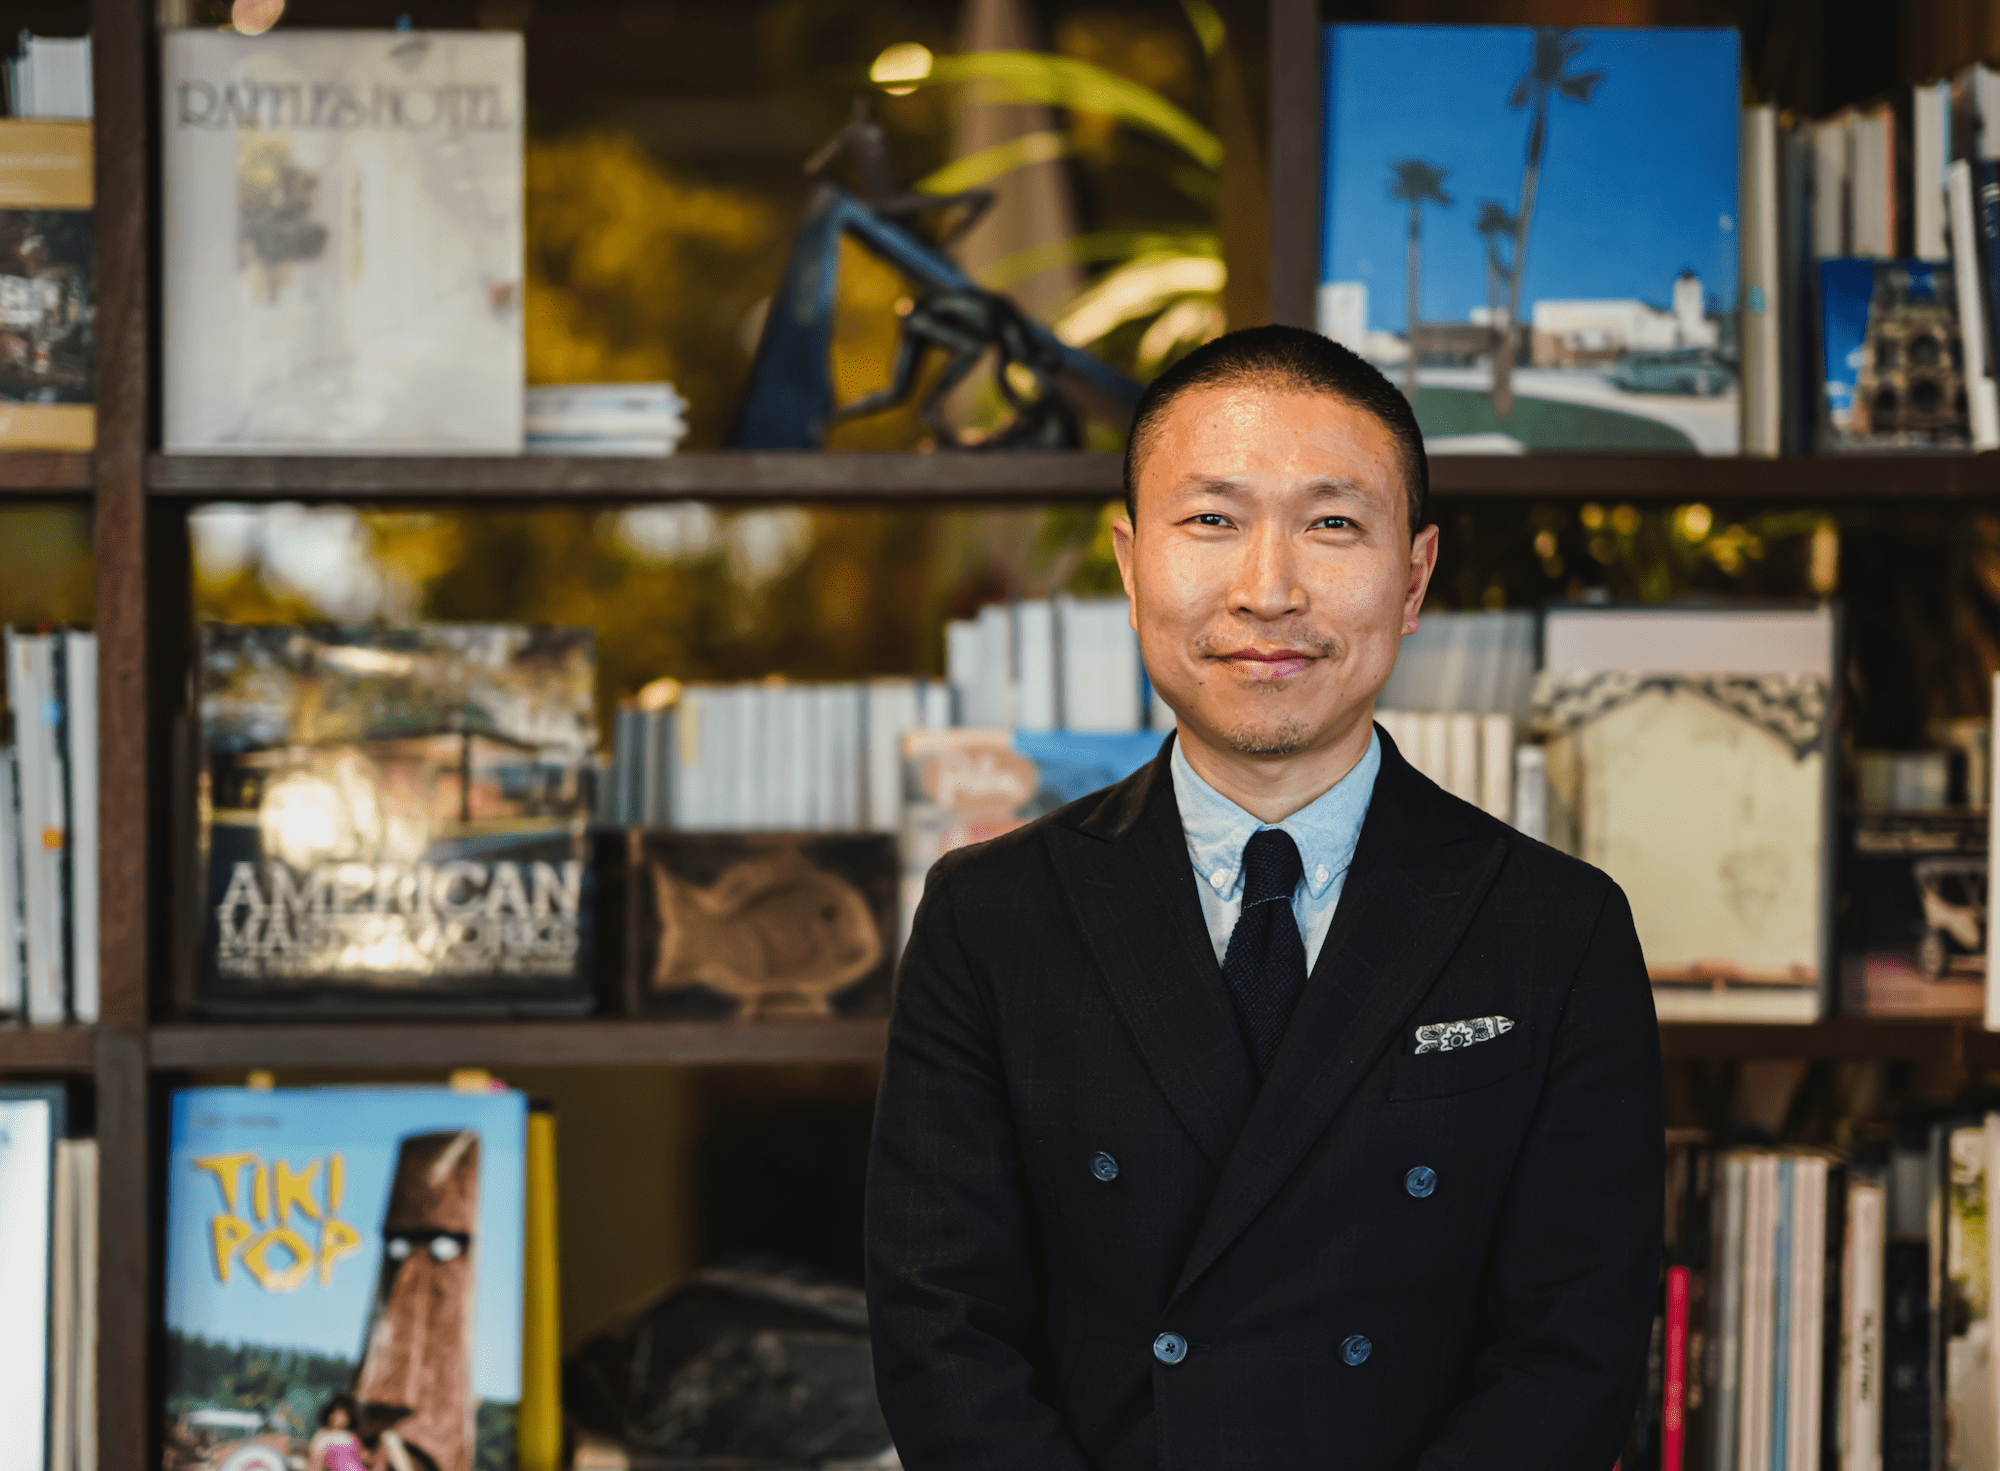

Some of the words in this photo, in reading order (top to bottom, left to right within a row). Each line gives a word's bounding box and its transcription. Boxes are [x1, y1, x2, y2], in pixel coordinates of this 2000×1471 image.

[216, 860, 583, 918] AMERICAN
[217, 912, 580, 957] MASWORKS
[194, 1152, 345, 1221] TIKI
[212, 1214, 361, 1291] POP
